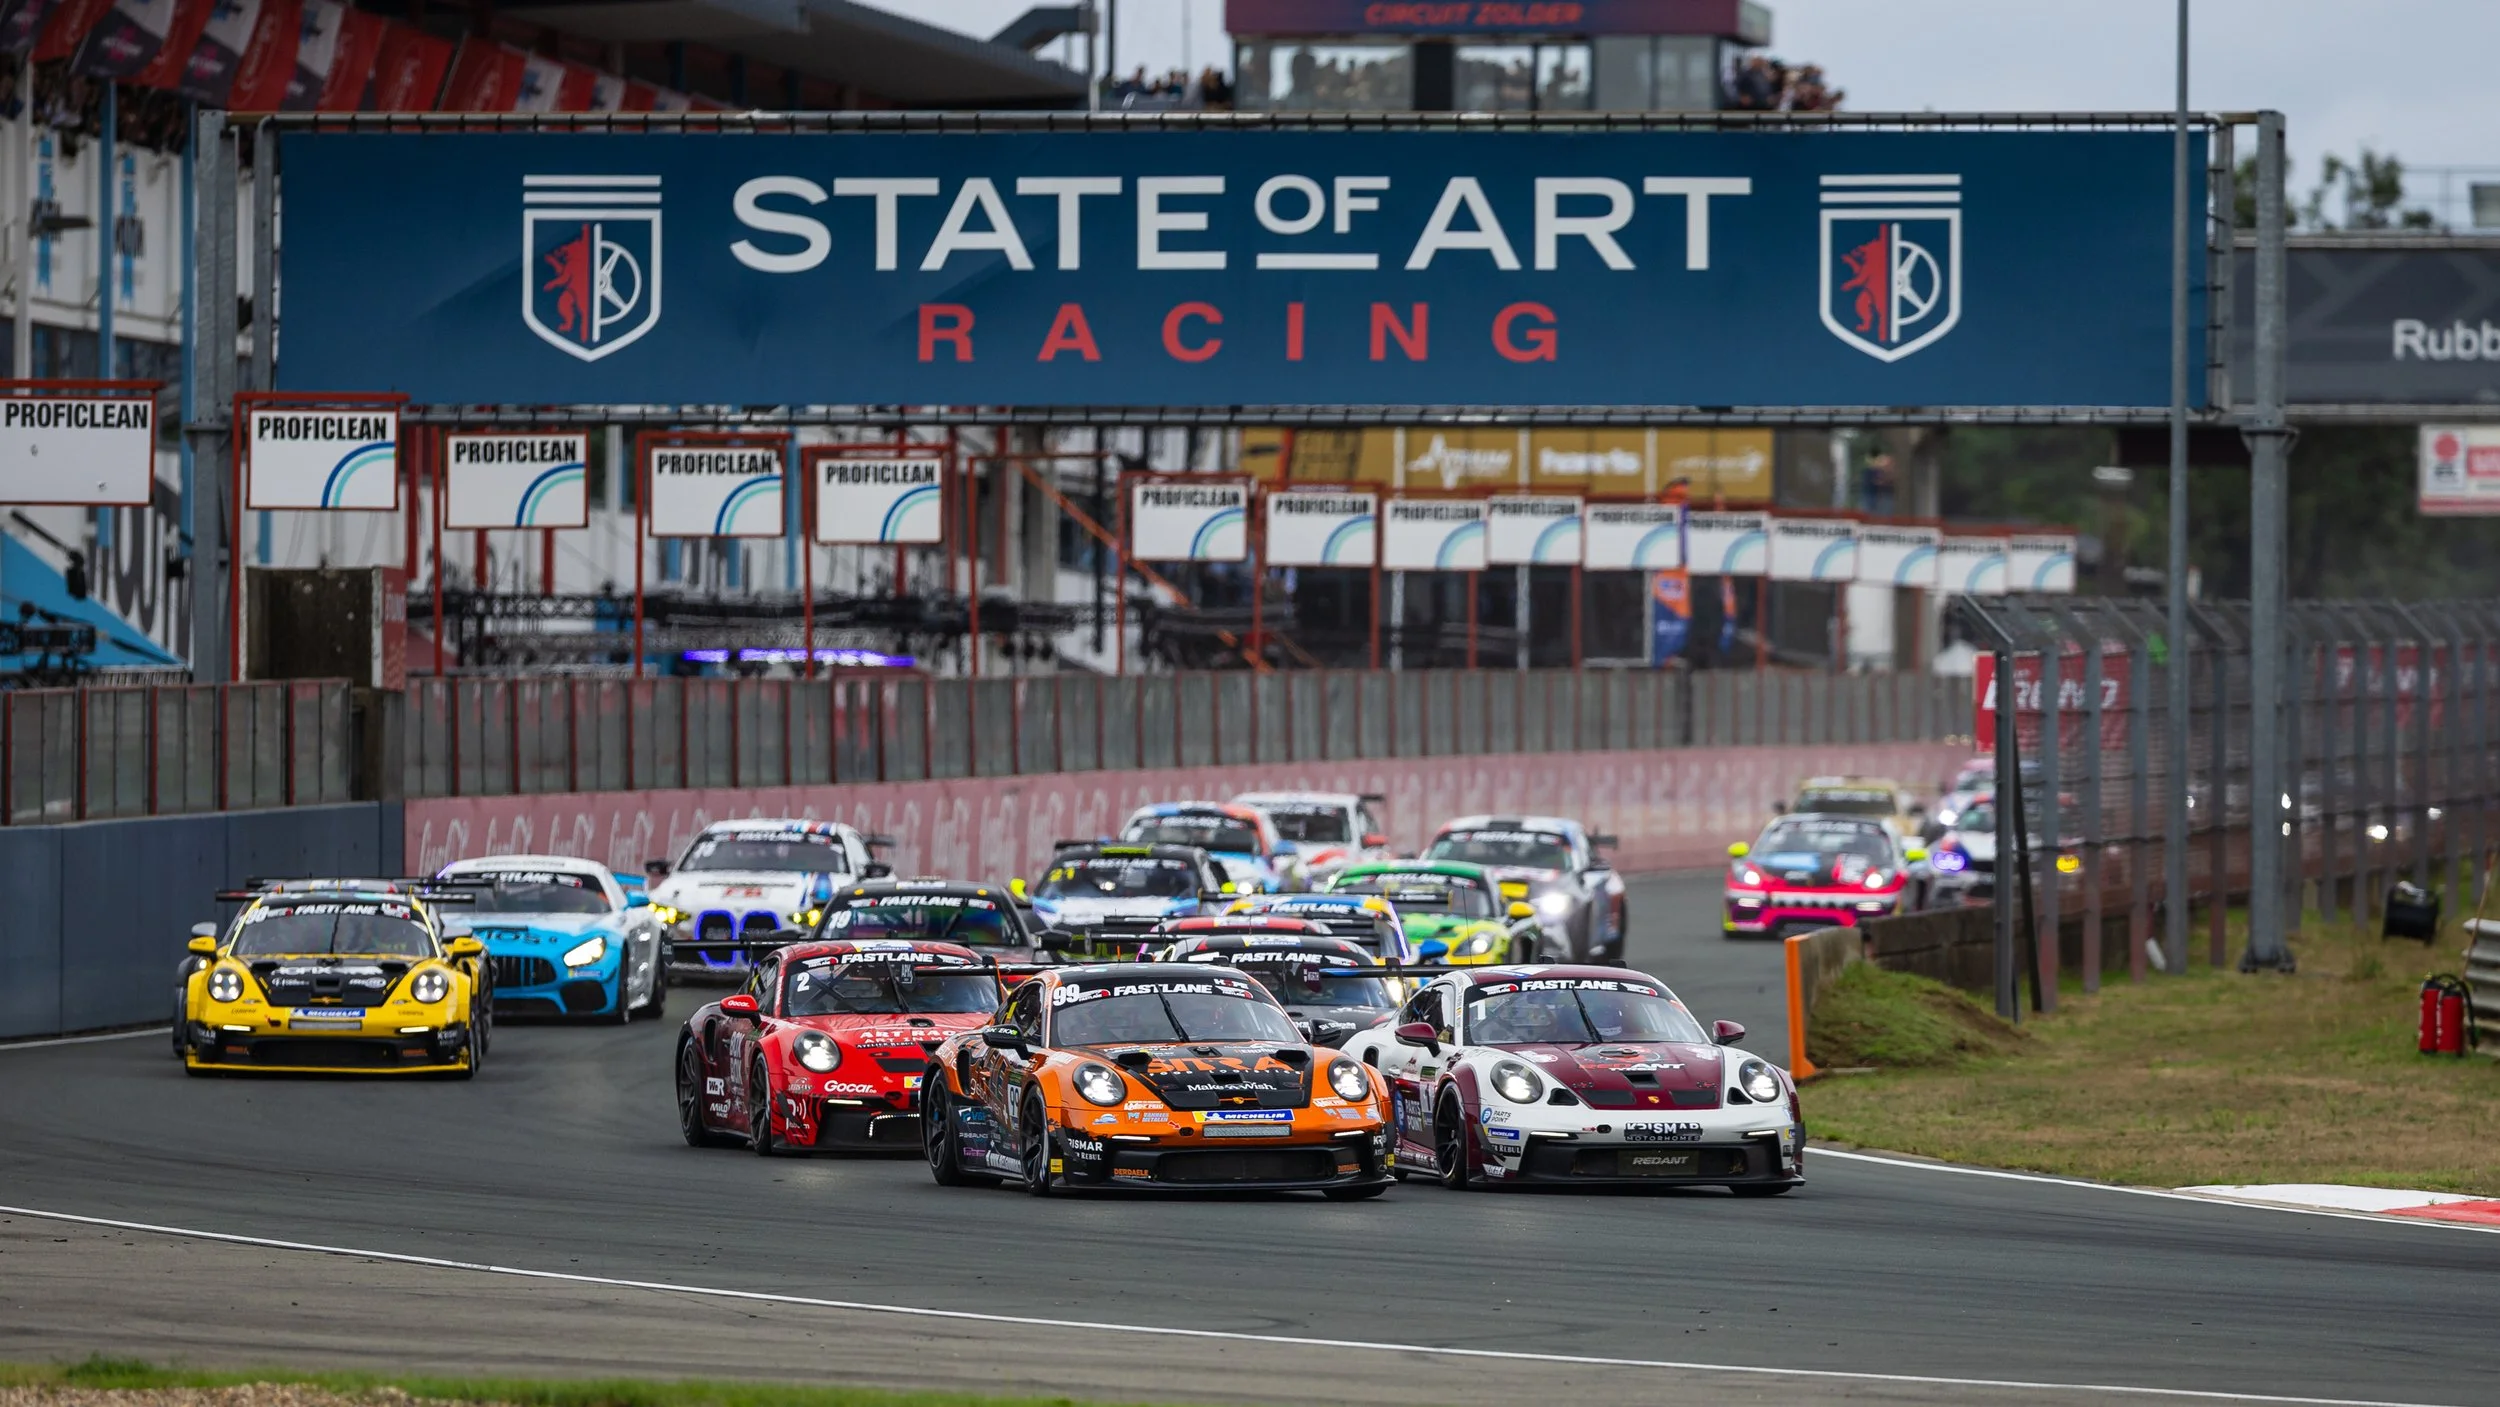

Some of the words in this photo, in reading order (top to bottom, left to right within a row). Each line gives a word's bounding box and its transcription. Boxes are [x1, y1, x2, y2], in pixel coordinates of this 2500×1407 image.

[1366, 3, 1467, 25] CIRCUIT
[1474, 3, 1583, 25] ZOLDER
[731, 175, 1227, 272] STATE
[1253, 174, 1390, 235] OF
[1404, 176, 1752, 270] ART
[918, 302, 1558, 362] RACING
[5, 402, 148, 429] PROFICLEAN
[258, 417, 387, 441] PROFICLEAN
[455, 441, 577, 464] PROFICLEAN
[657, 454, 776, 475] PROFICLEAN
[825, 464, 935, 485] PROFICLEAN
[879, 896, 963, 906] FASTLANE
[828, 910, 852, 929] 19
[841, 953, 934, 964] FASTLANE
[1230, 953, 1323, 964] FASTLANE
[796, 972, 810, 992] 2
[1113, 983, 1213, 997] FASTLANE
[1521, 980, 1618, 991] FASTLANE
[1053, 984, 1081, 1006] 99
[1469, 1000, 1486, 1020] 1
[860, 1030, 904, 1039] ART
[1493, 1110, 1512, 1118] PARTS
[1632, 1156, 1689, 1165] REDANT
[1113, 1168, 1149, 1177] DERDAELE
